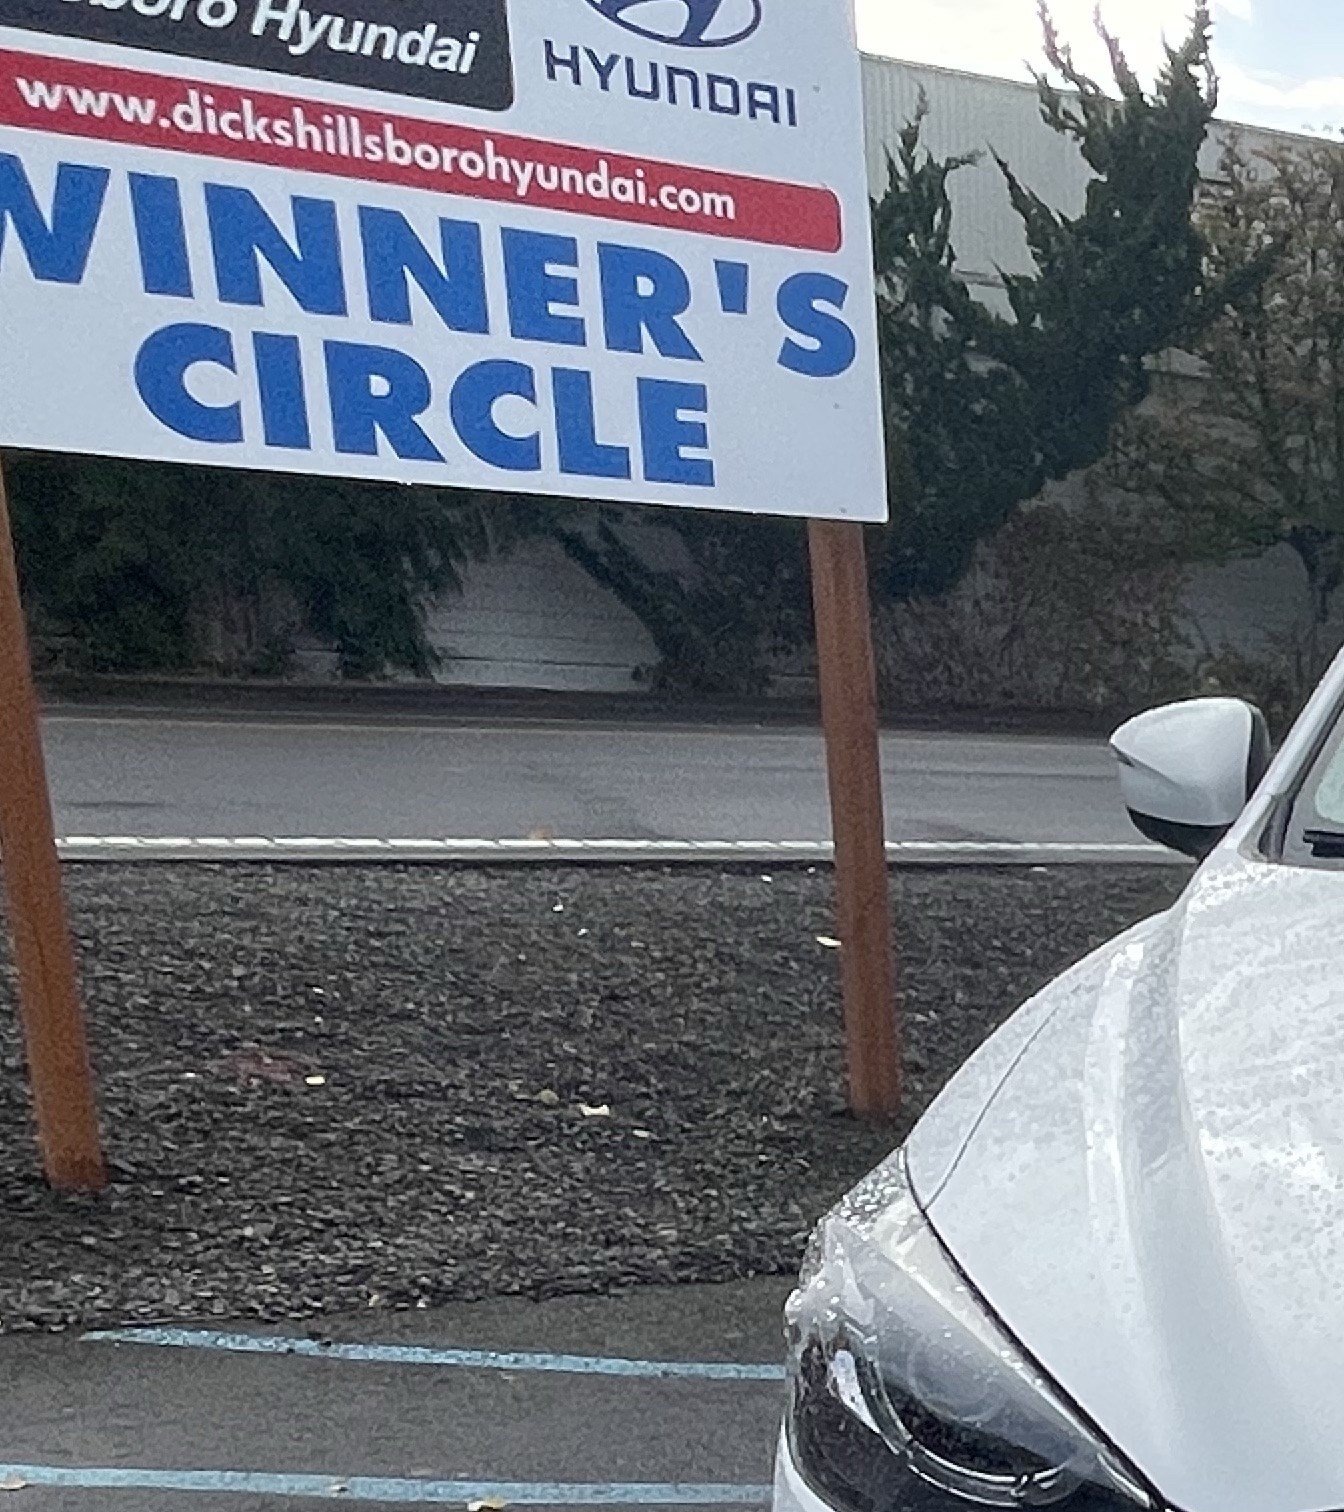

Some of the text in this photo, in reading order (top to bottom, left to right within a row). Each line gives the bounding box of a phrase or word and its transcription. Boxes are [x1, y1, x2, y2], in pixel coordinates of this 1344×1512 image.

[250, 0, 481, 74] Hyundai
[543, 40, 799, 127] HYUNDAI
[14, 76, 737, 220] www.dickshillsborohyundai.com
[134, 322, 716, 487] CIRCLE
